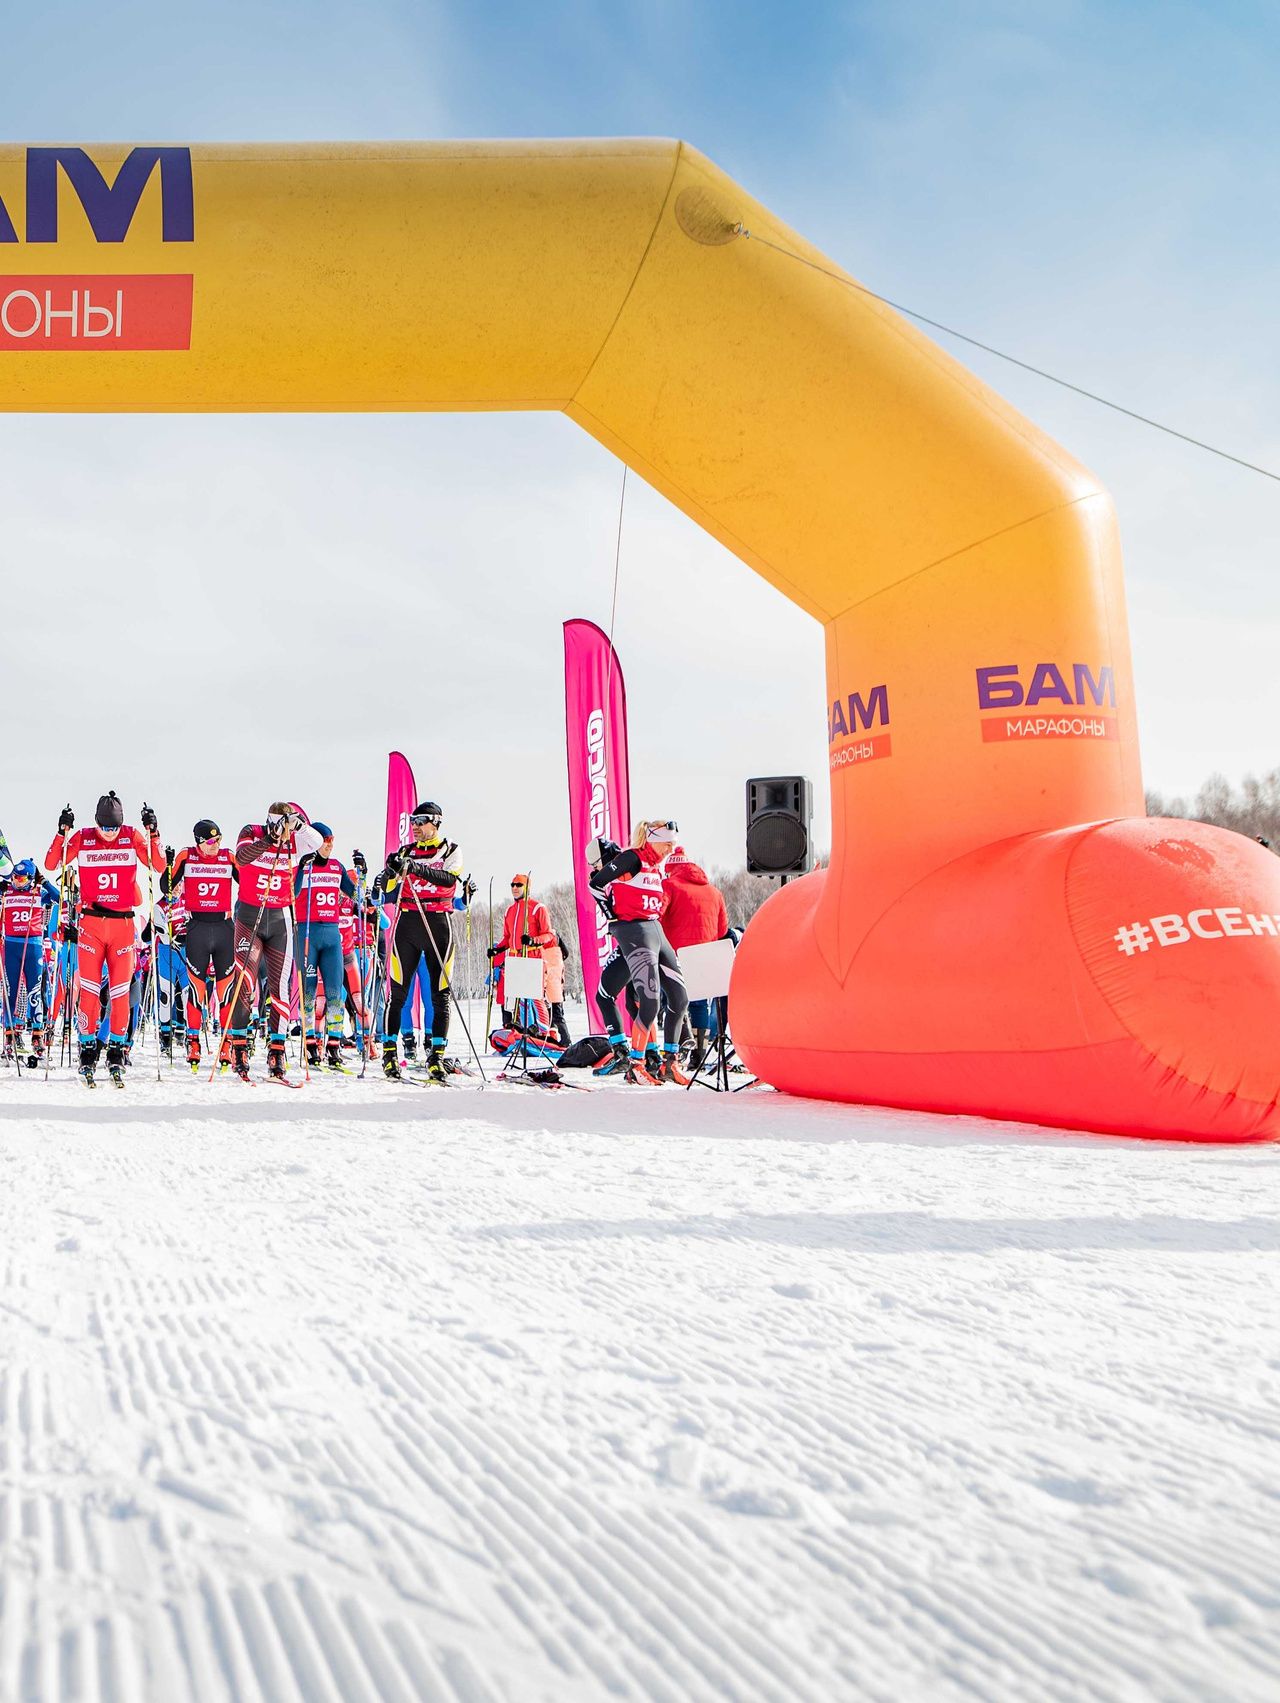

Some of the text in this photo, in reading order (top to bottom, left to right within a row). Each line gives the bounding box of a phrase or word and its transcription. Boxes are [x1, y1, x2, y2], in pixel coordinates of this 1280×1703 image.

[975, 663, 1117, 710] БАМ
[1006, 718, 1105, 737] МАРАФОНЫ
[97, 873, 118, 890] 91
[197, 882, 220, 897] 97
[256, 874, 282, 891] 58
[315, 892, 336, 906] 96
[12, 911, 30, 923] 28
